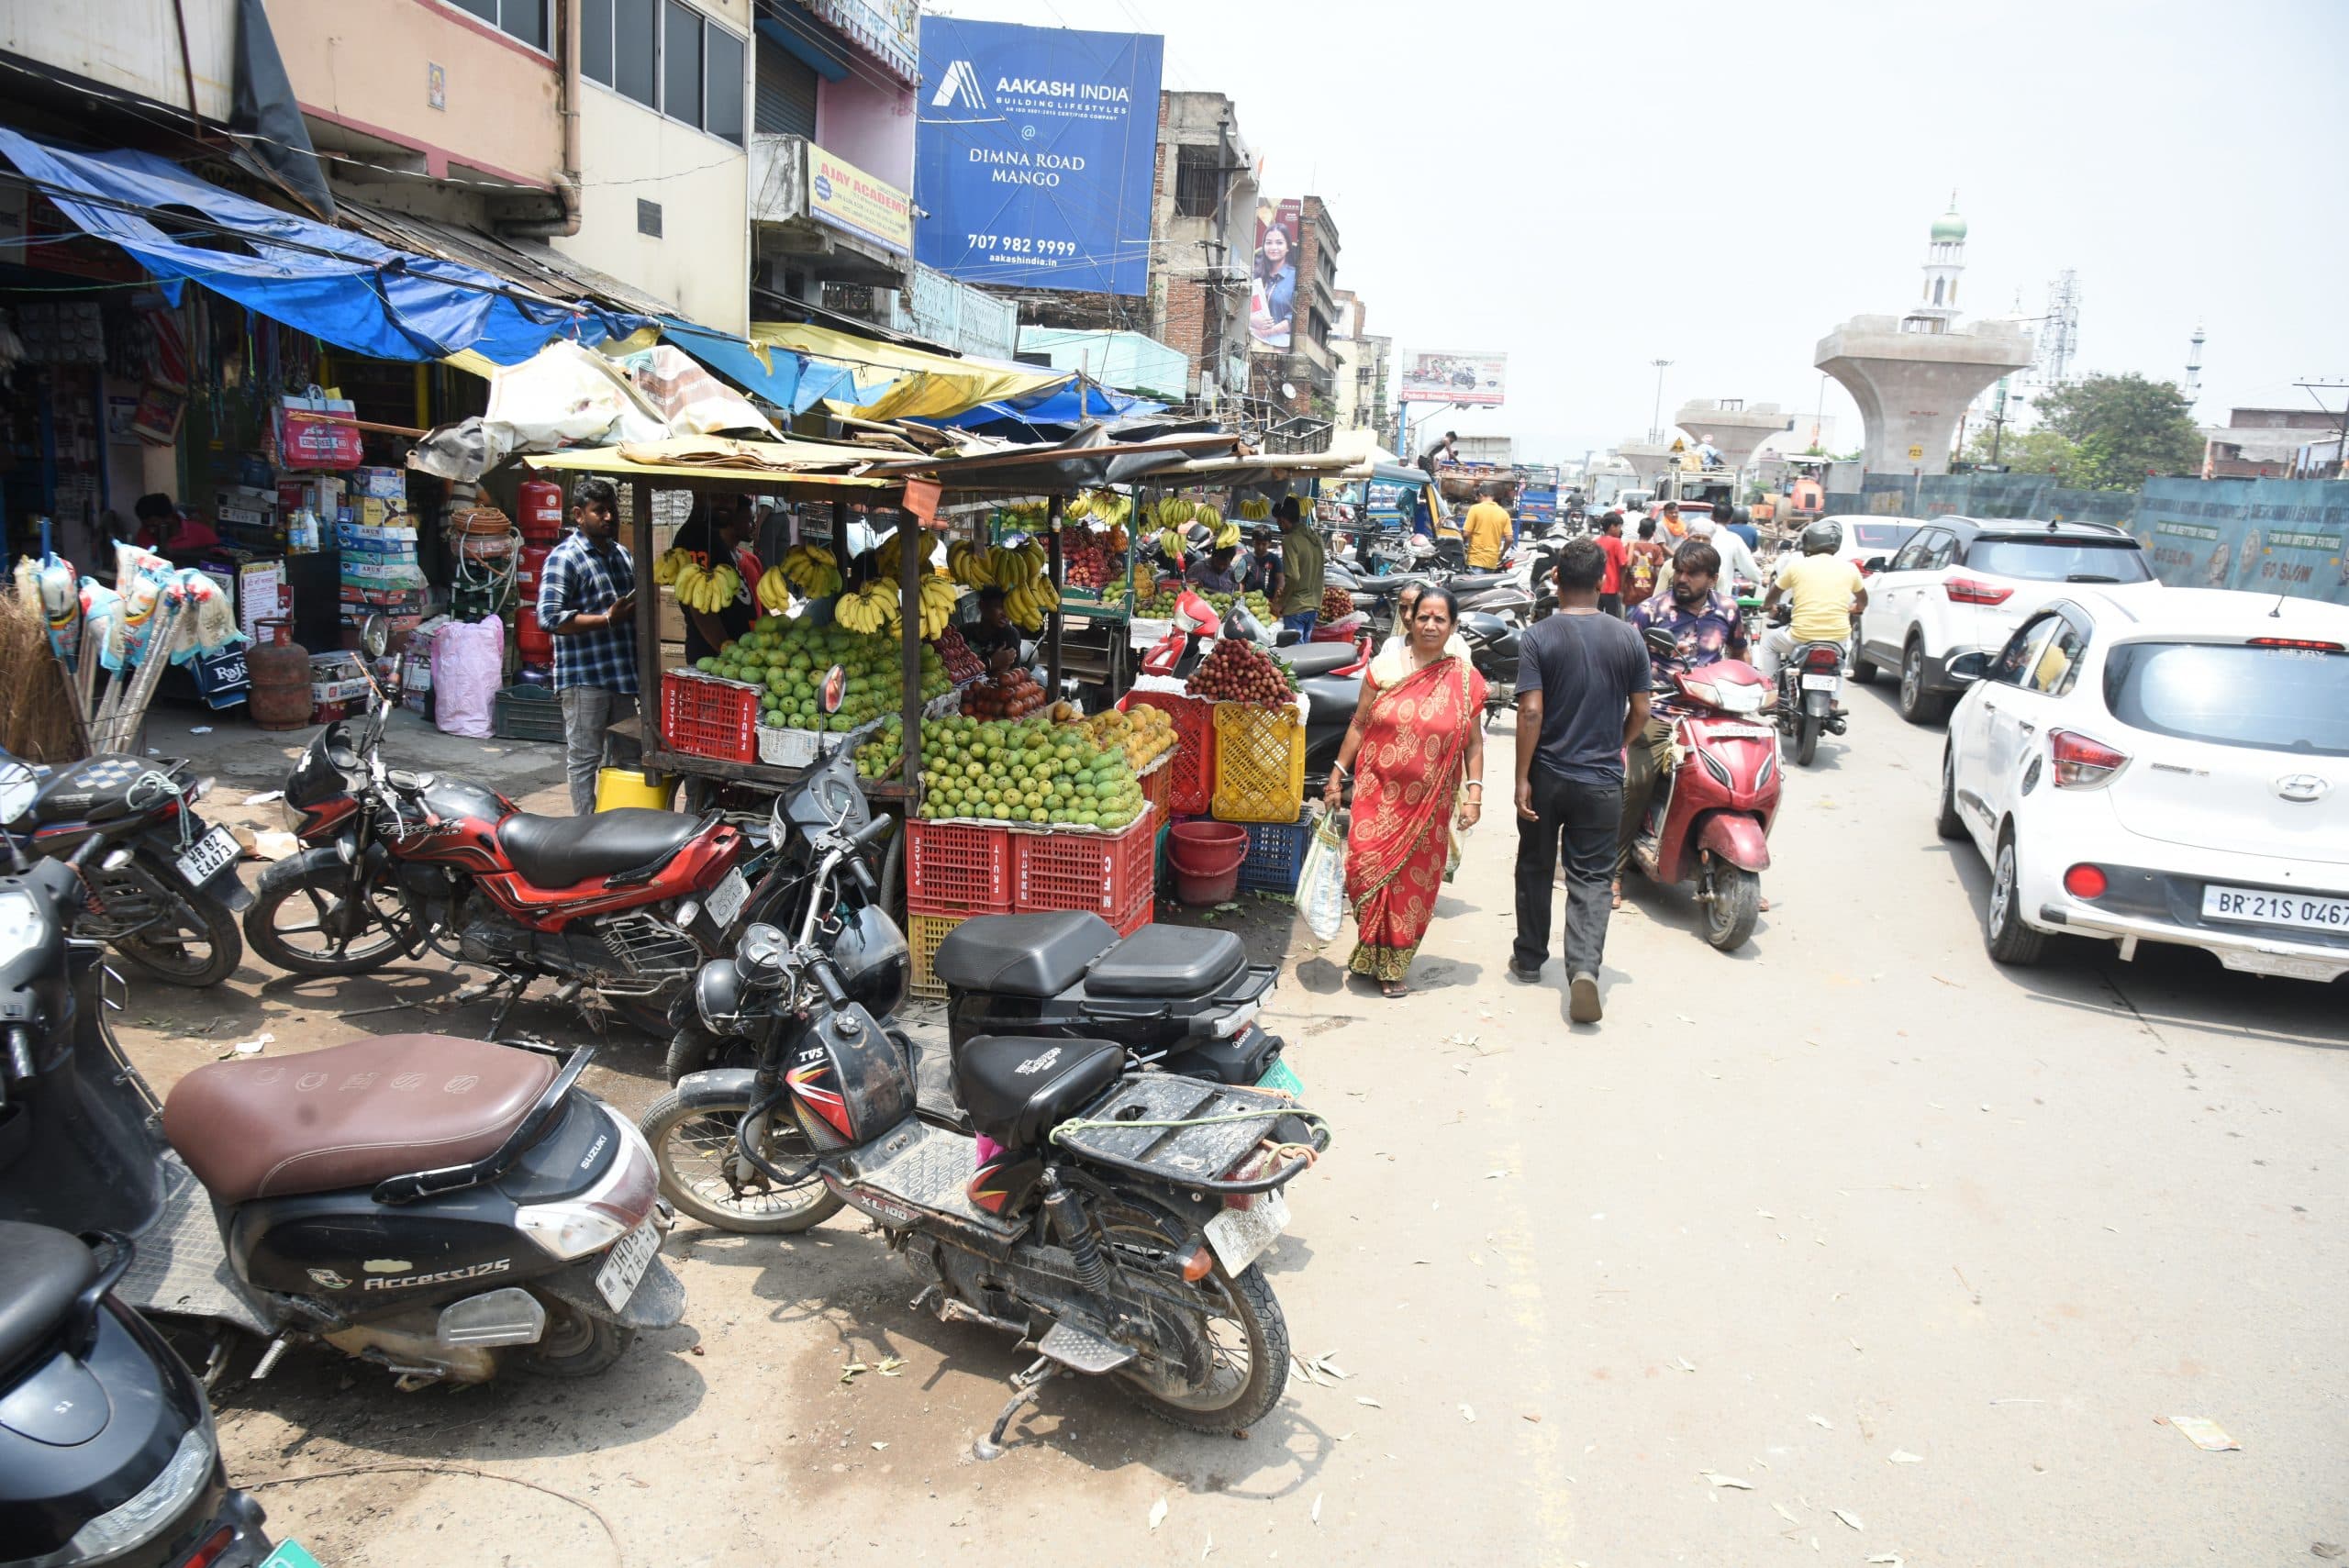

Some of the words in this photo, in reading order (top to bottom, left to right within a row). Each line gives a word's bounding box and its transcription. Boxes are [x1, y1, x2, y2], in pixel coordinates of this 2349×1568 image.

[996, 77, 1074, 97] AAKASH
[1081, 84, 1129, 102] INDIA
[996, 97, 1054, 107] BUILDING
[1058, 103, 1127, 115] LIFESTYLES
[1021, 125, 1036, 140] @
[969, 149, 1030, 166] DIMNA
[1036, 153, 1085, 171] ROAD
[992, 169, 1060, 186] MANGO
[821, 162, 851, 186] AJAY
[853, 180, 907, 216] ACADEMY
[968, 234, 997, 249] 707
[1002, 237, 1031, 252] 982
[1037, 239, 1076, 256] 9999
[989, 254, 1057, 267] aakashindia.in
[2279, 563, 2312, 582] SLOW
[205, 834, 221, 851] 82
[196, 844, 232, 878] E4473
[2219, 893, 2245, 914] BR
[2254, 897, 2293, 918] 21S
[799, 1047, 824, 1062] TVS
[581, 1135, 607, 1170] SUZUKI
[861, 1195, 882, 1211] XL
[885, 1205, 907, 1221] 100
